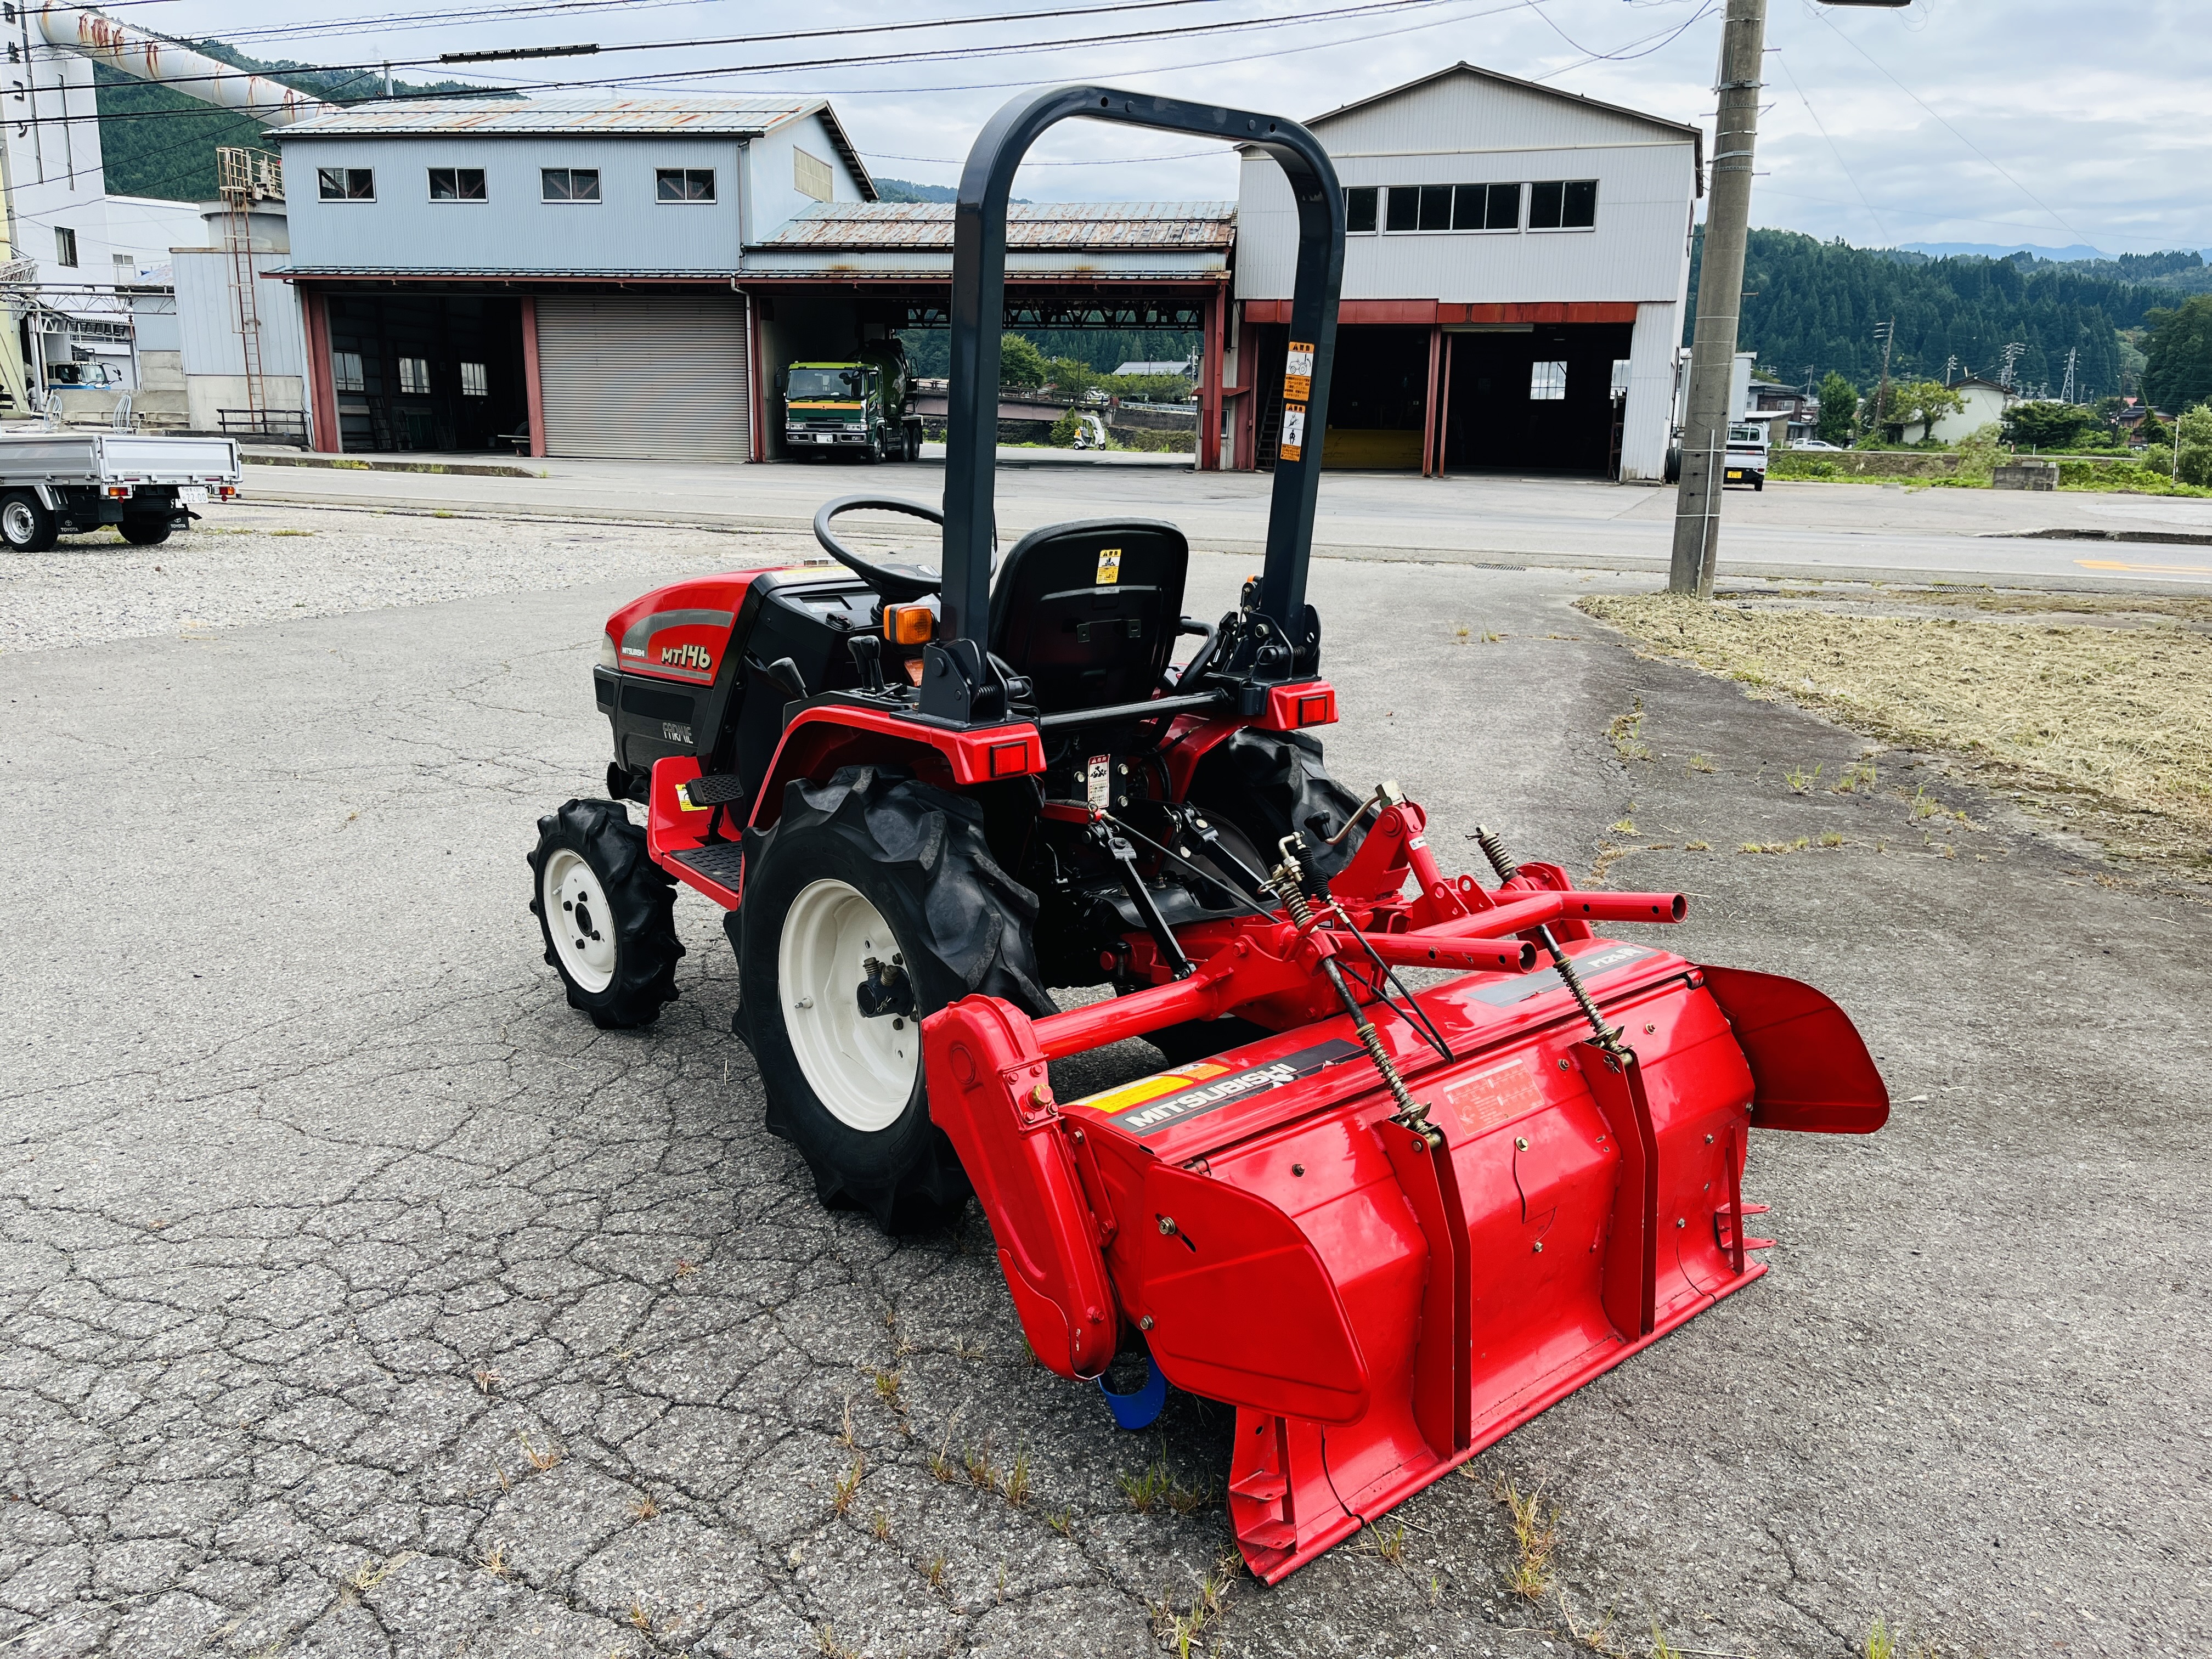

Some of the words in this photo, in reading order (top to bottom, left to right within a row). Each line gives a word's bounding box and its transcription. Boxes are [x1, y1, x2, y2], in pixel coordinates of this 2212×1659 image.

[622, 647, 645, 657] MITSUBISHI
[661, 644, 712, 670] MT146
[1125, 1063, 1298, 1128] MITSUBISHI
